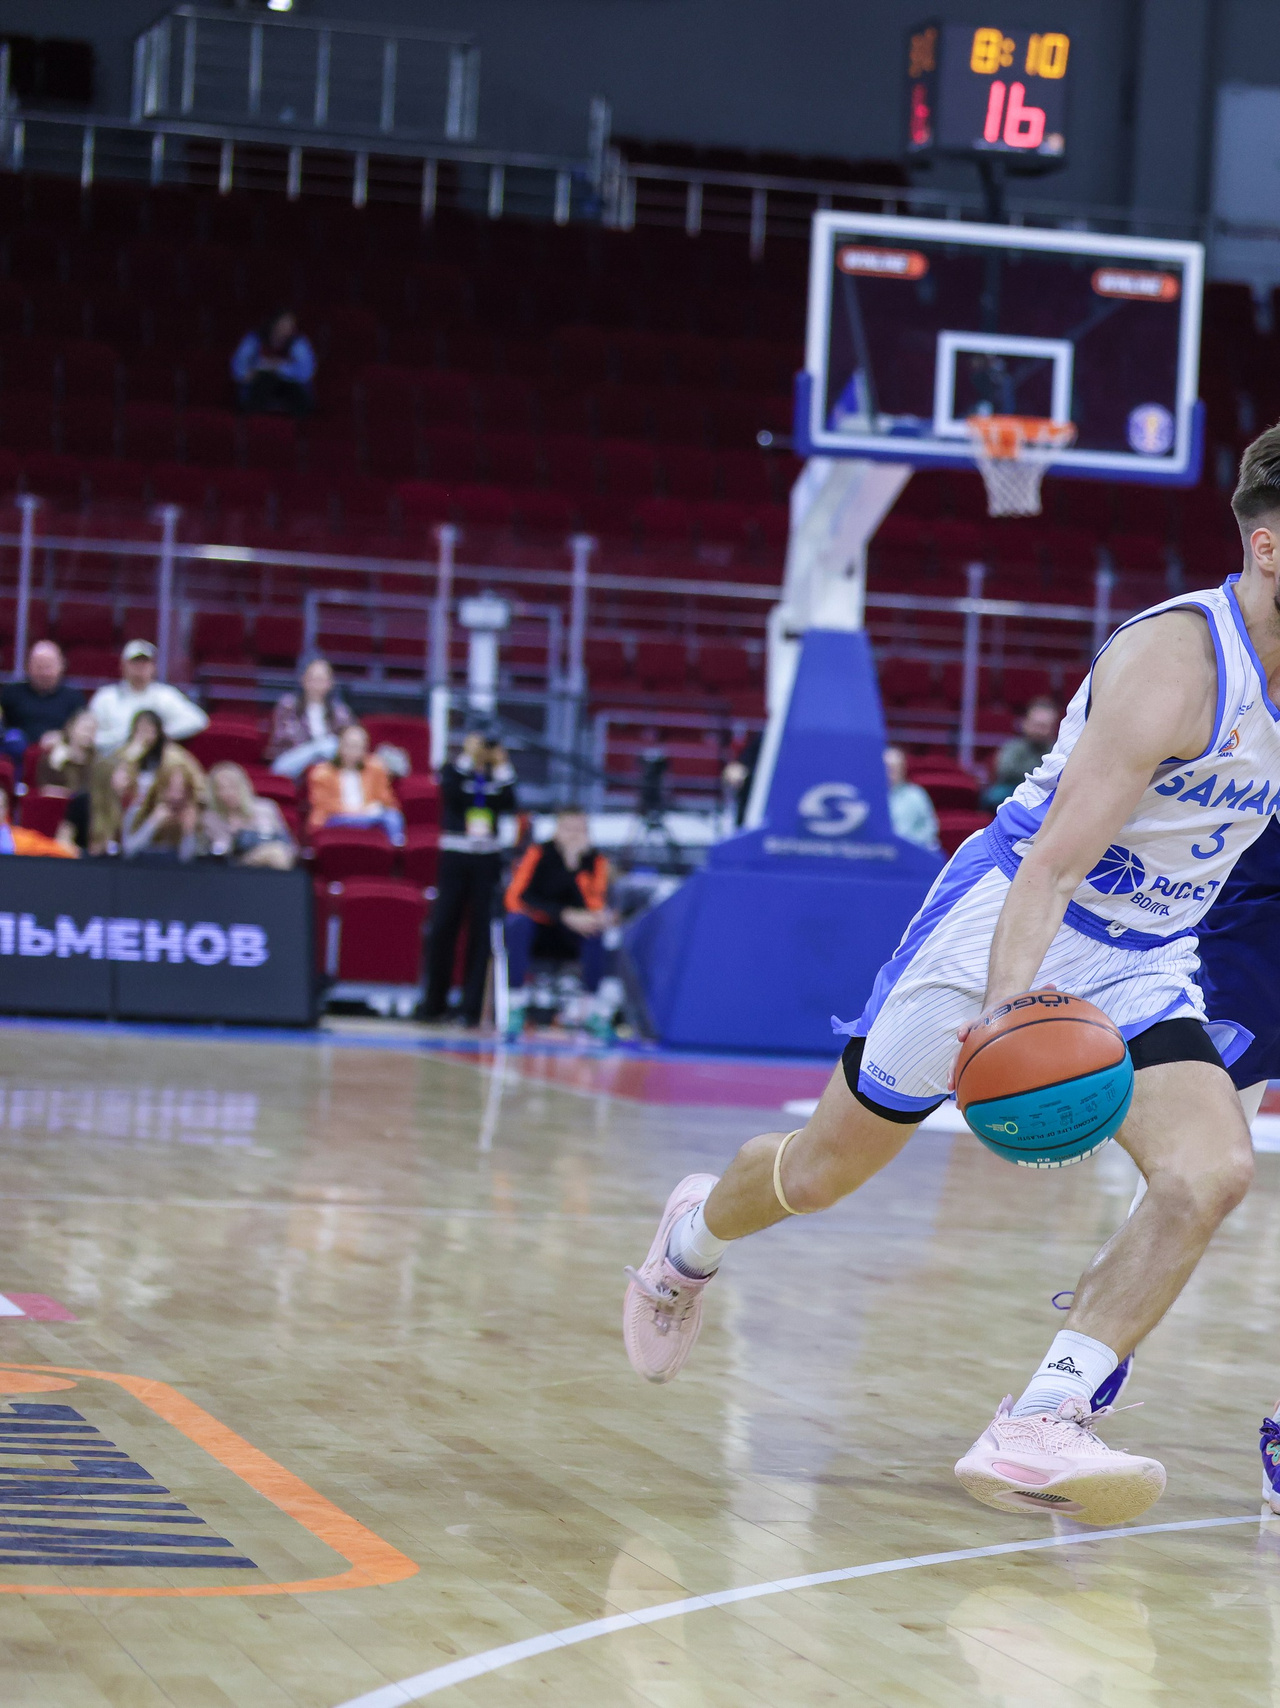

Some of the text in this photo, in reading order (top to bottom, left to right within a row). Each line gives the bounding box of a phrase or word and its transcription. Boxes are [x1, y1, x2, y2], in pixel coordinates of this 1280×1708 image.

[970, 27, 1070, 79] 8:10
[983, 80, 1046, 148] 16
[1191, 822, 1234, 860] 3
[866, 1060, 896, 1087] ZEDO
[1047, 1362, 1083, 1377] PEAK
